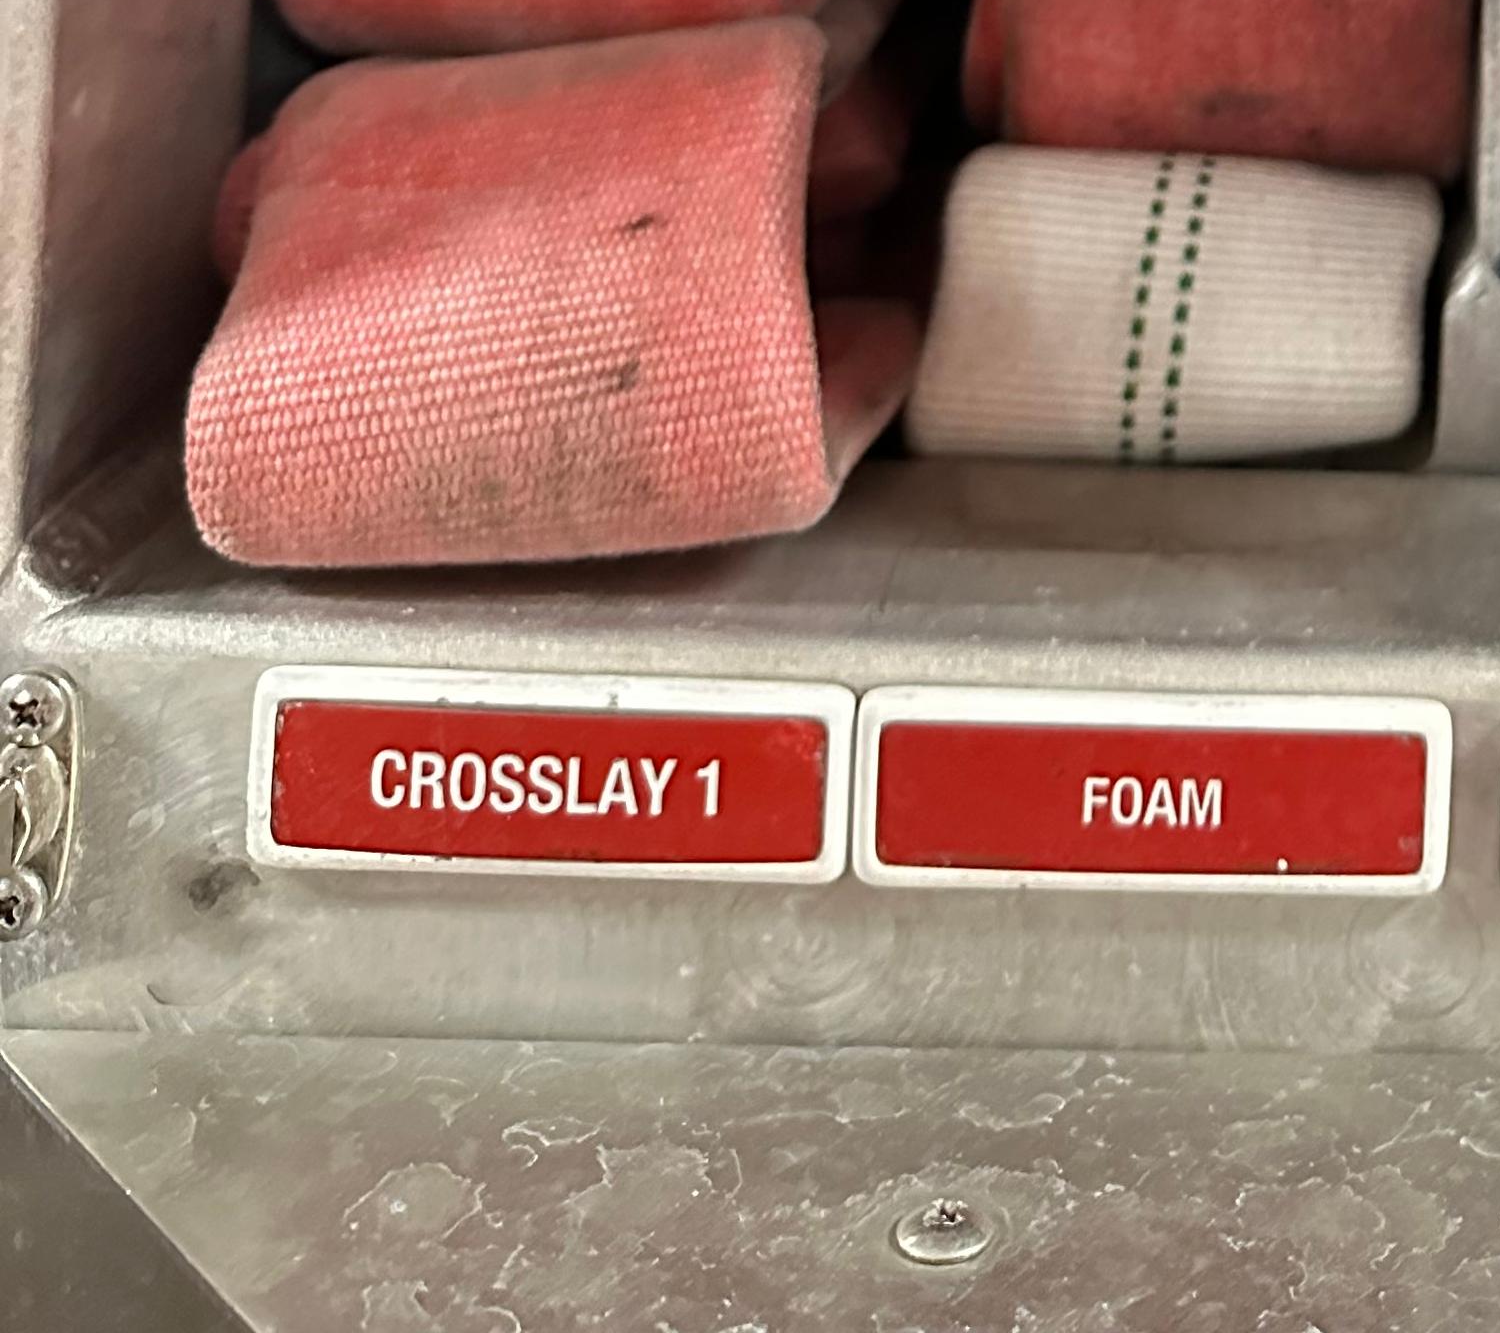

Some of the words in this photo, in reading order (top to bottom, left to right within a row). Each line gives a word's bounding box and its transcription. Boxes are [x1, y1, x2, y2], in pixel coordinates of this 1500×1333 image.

[369, 748, 678, 818] CROSSLAY
[695, 758, 721, 818] 1
[1081, 775, 1223, 830] FOAM
